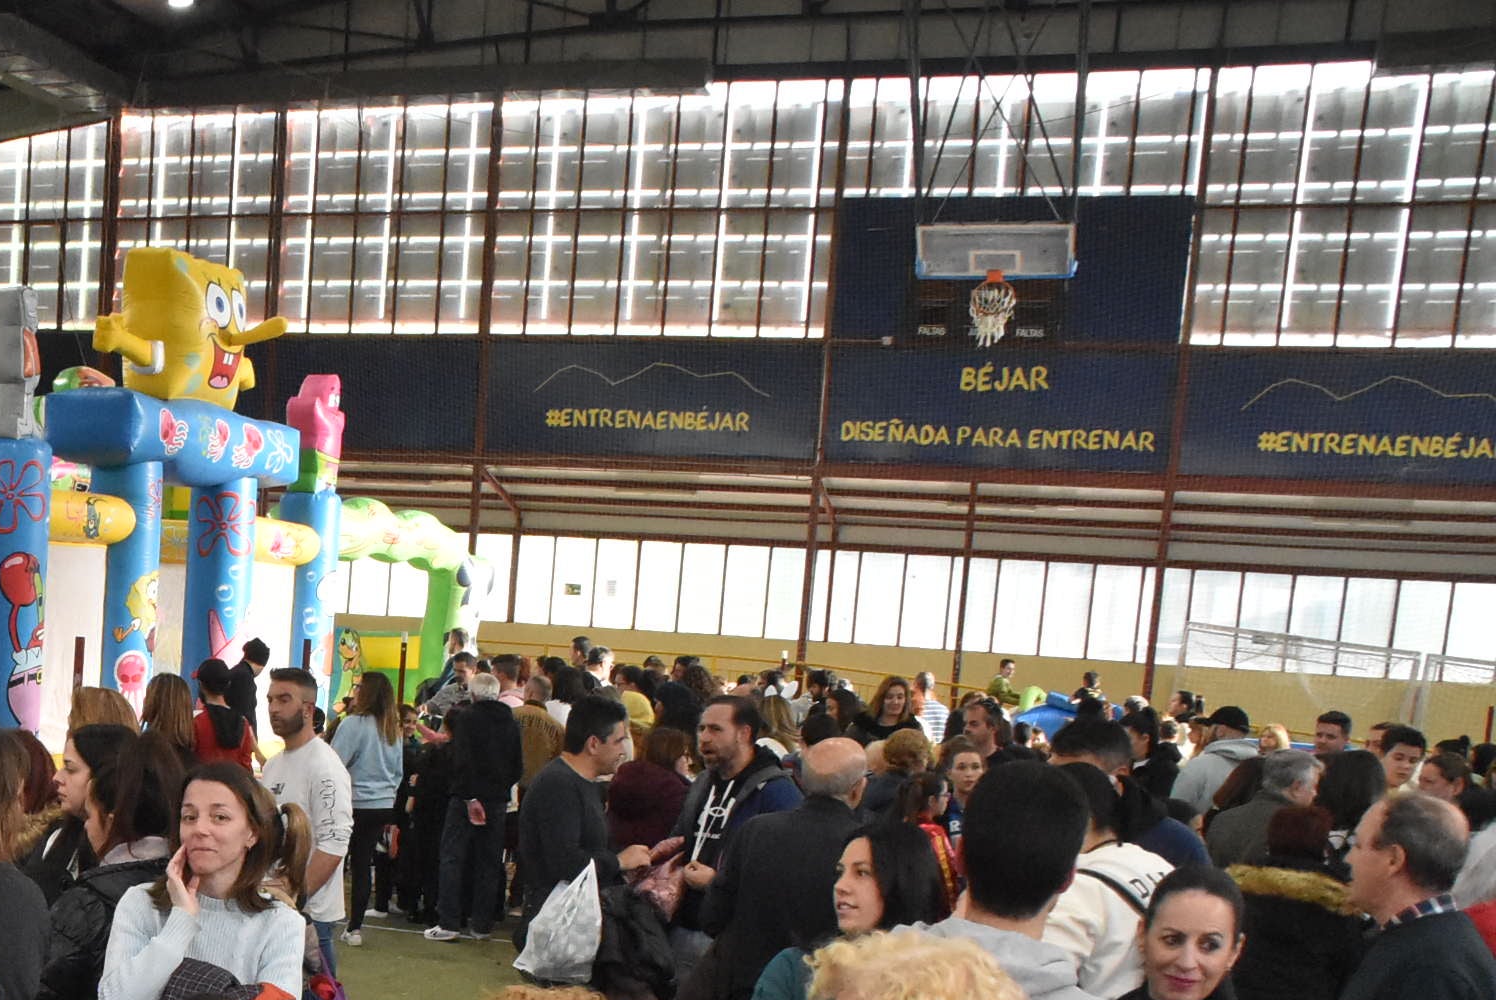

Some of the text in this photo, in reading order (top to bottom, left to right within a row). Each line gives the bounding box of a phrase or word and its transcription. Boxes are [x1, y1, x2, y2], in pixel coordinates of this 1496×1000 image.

[960, 362, 1049, 392] BÉJAR
[545, 405, 750, 432] #ENTRENAENBÉJAR
[840, 418, 1155, 452] DISEÑADA PARA ENTRENAR
[1257, 431, 1496, 459] #ENTRENAENBÉJA
